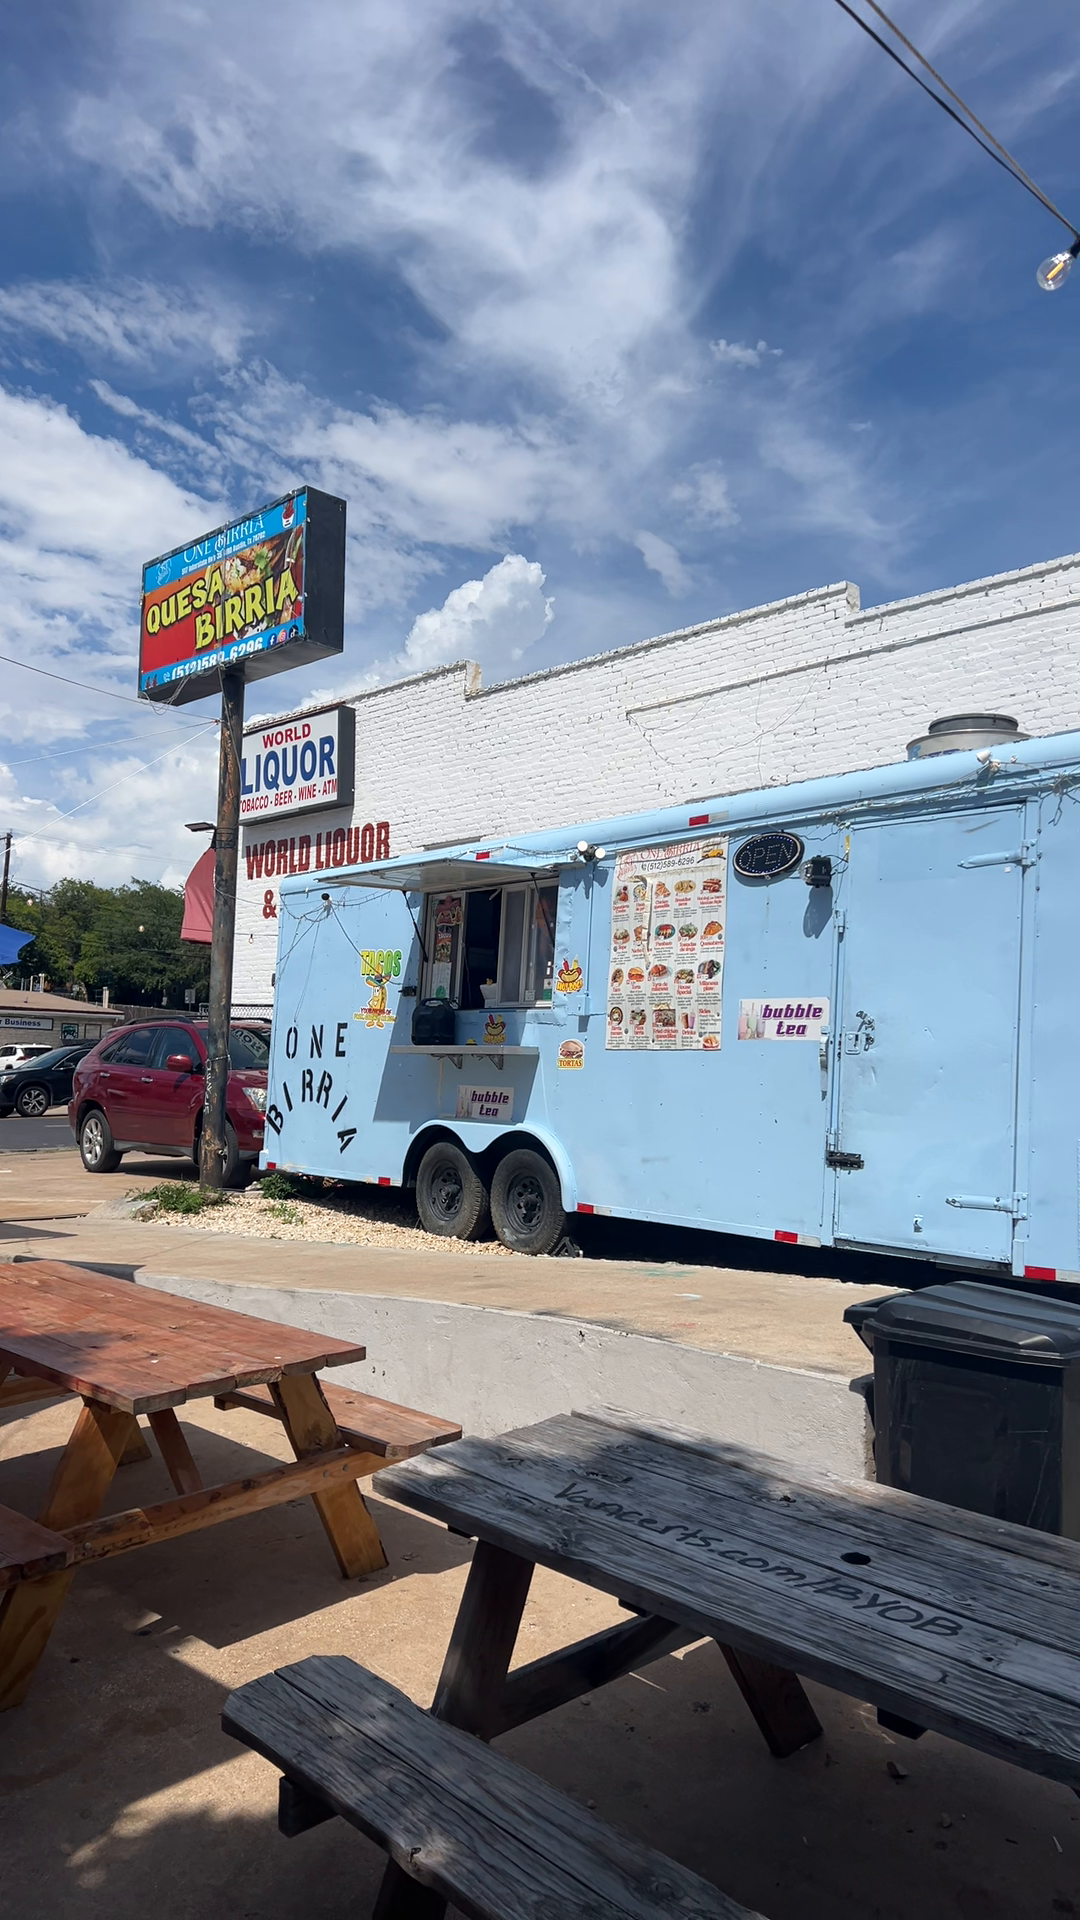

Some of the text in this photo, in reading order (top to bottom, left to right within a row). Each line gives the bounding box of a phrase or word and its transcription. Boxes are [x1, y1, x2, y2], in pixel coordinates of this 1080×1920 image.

[184, 514, 264, 562] ONE BIRRIA
[146, 566, 225, 634] QUESA
[195, 568, 298, 650] BIRRIA
[262, 723, 311, 749] WORLD
[242, 735, 335, 795] LIQUOR
[240, 778, 338, 813] OBACCO BEER WINE ATM
[246, 822, 390, 880] WORLD LIQUOR
[739, 842, 794, 868] OPEN
[262, 890, 277, 919] &
[361, 950, 402, 977] TACOS
[5, 1018, 41, 1026] Business
[762, 1004, 823, 1018] bubble
[286, 1022, 348, 1059] ONE
[776, 1021, 807, 1035] tea
[266, 1068, 357, 1154] BIRRIA
[471, 1090, 509, 1104] bubble
[479, 1104, 499, 1116] tea
